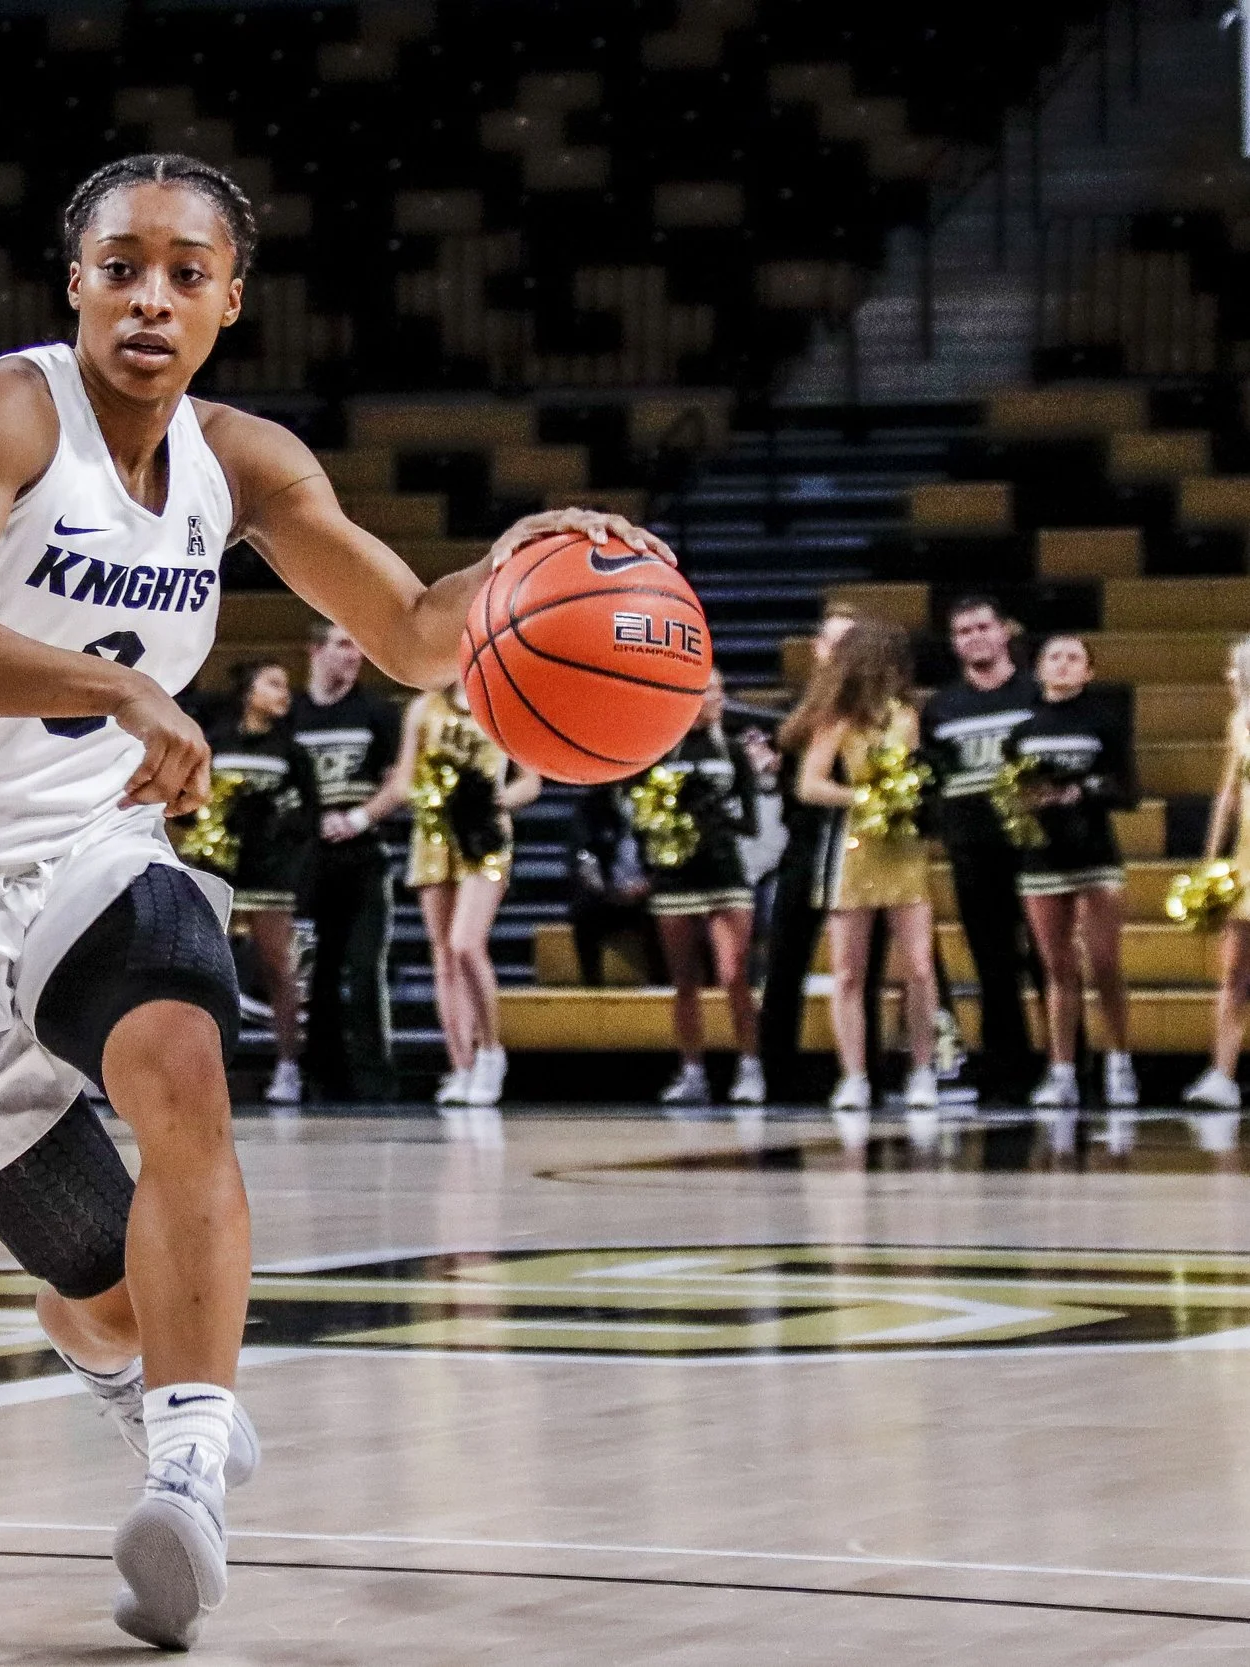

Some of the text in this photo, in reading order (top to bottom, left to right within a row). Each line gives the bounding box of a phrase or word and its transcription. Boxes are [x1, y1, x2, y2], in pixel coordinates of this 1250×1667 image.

[25, 543, 216, 613] KNIGHTS
[613, 644, 703, 667] CHAMPIONSHIP
[614, 611, 703, 656] ELITE
